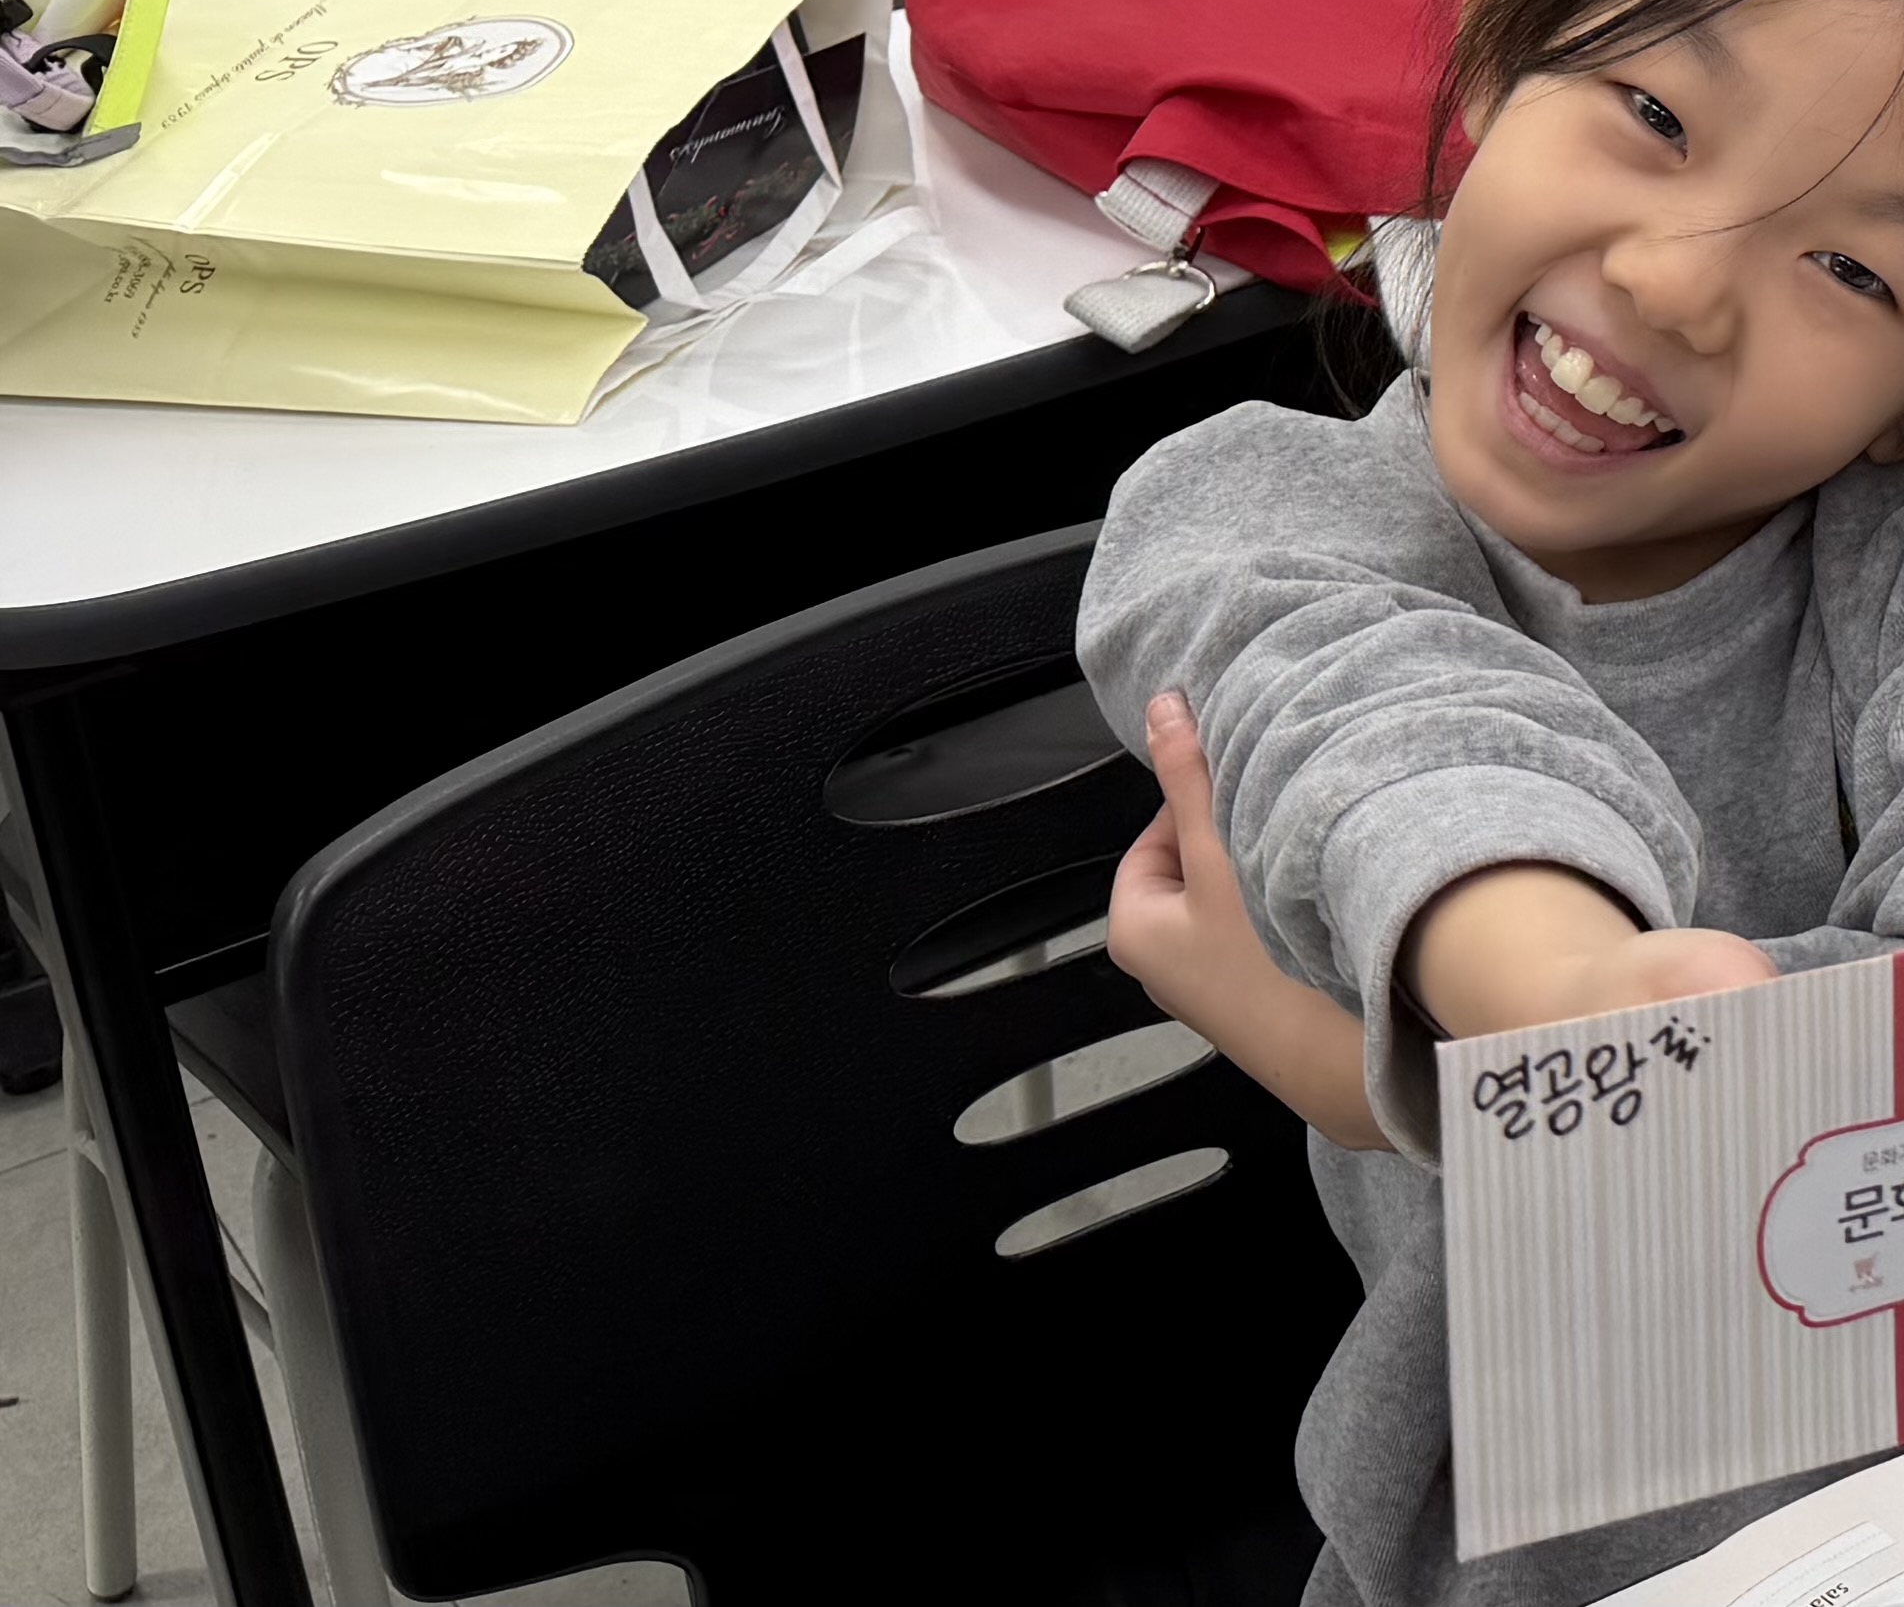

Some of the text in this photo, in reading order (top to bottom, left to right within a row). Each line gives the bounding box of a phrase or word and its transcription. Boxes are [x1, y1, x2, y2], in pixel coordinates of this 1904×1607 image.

[255, 41, 339, 82] OPS
[180, 254, 216, 294] OPS
[1474, 1041, 1649, 1140] 열공왕
[1804, 1582, 1850, 1607] sala
